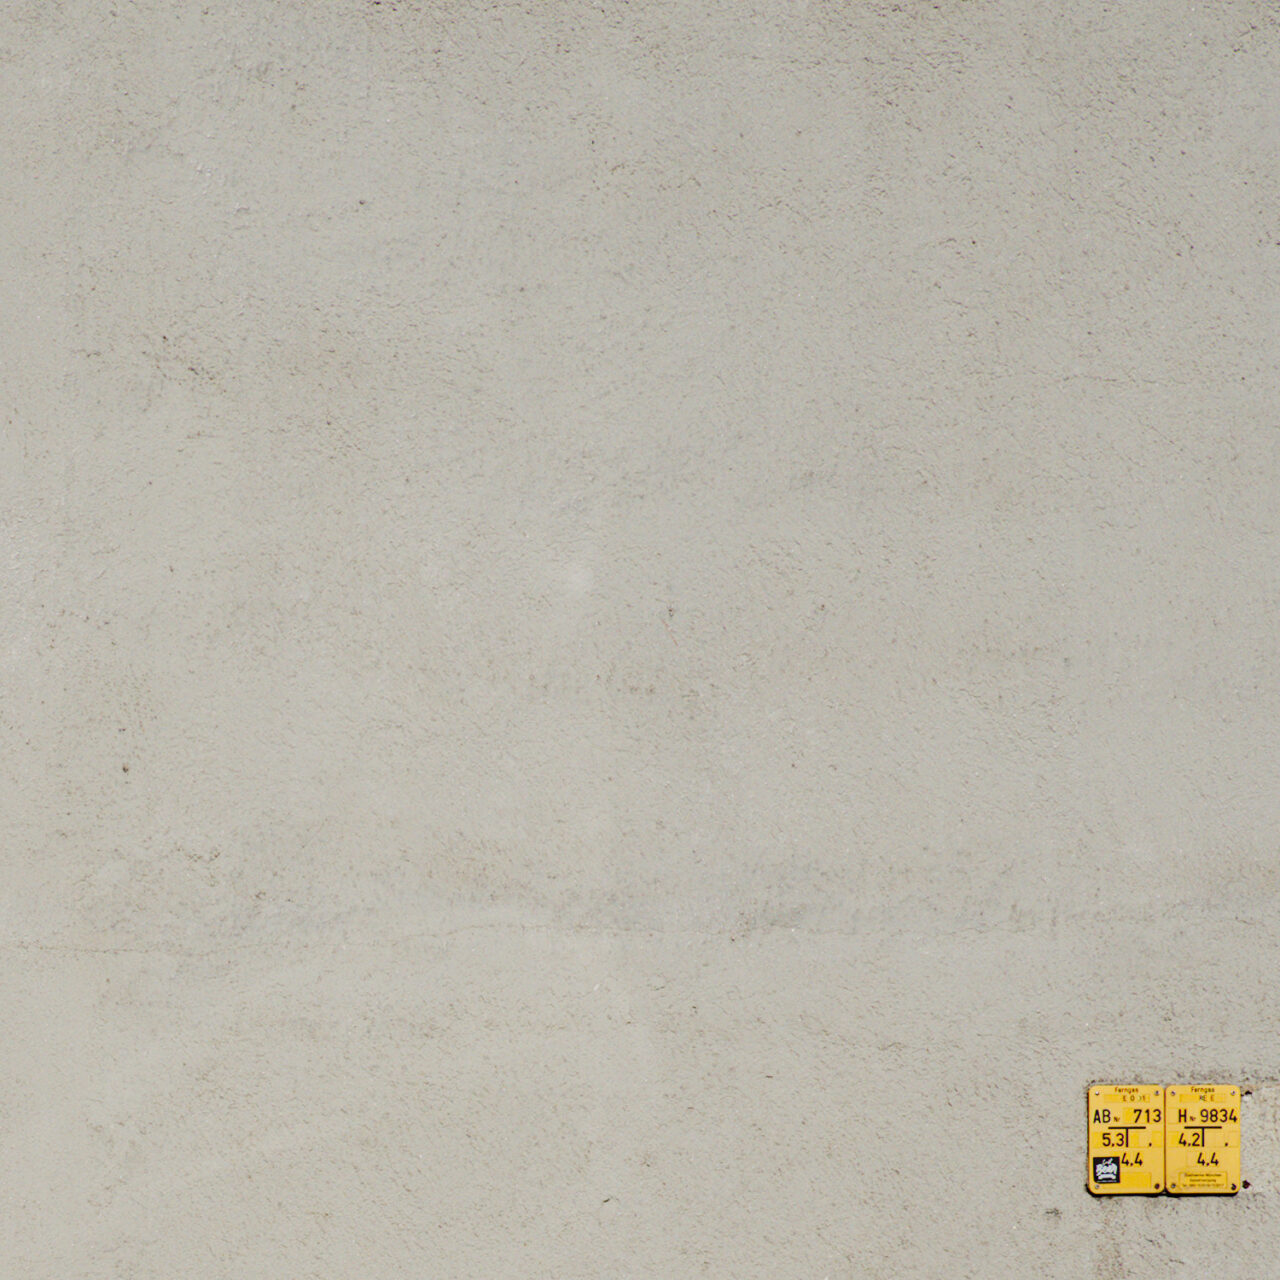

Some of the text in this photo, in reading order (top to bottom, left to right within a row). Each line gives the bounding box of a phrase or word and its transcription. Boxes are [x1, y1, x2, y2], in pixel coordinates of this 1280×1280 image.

[1093, 1108, 1111, 1124] AB
[1133, 1108, 1162, 1124] 713
[1178, 1108, 1187, 1123] H
[1200, 1108, 1237, 1123] 9834
